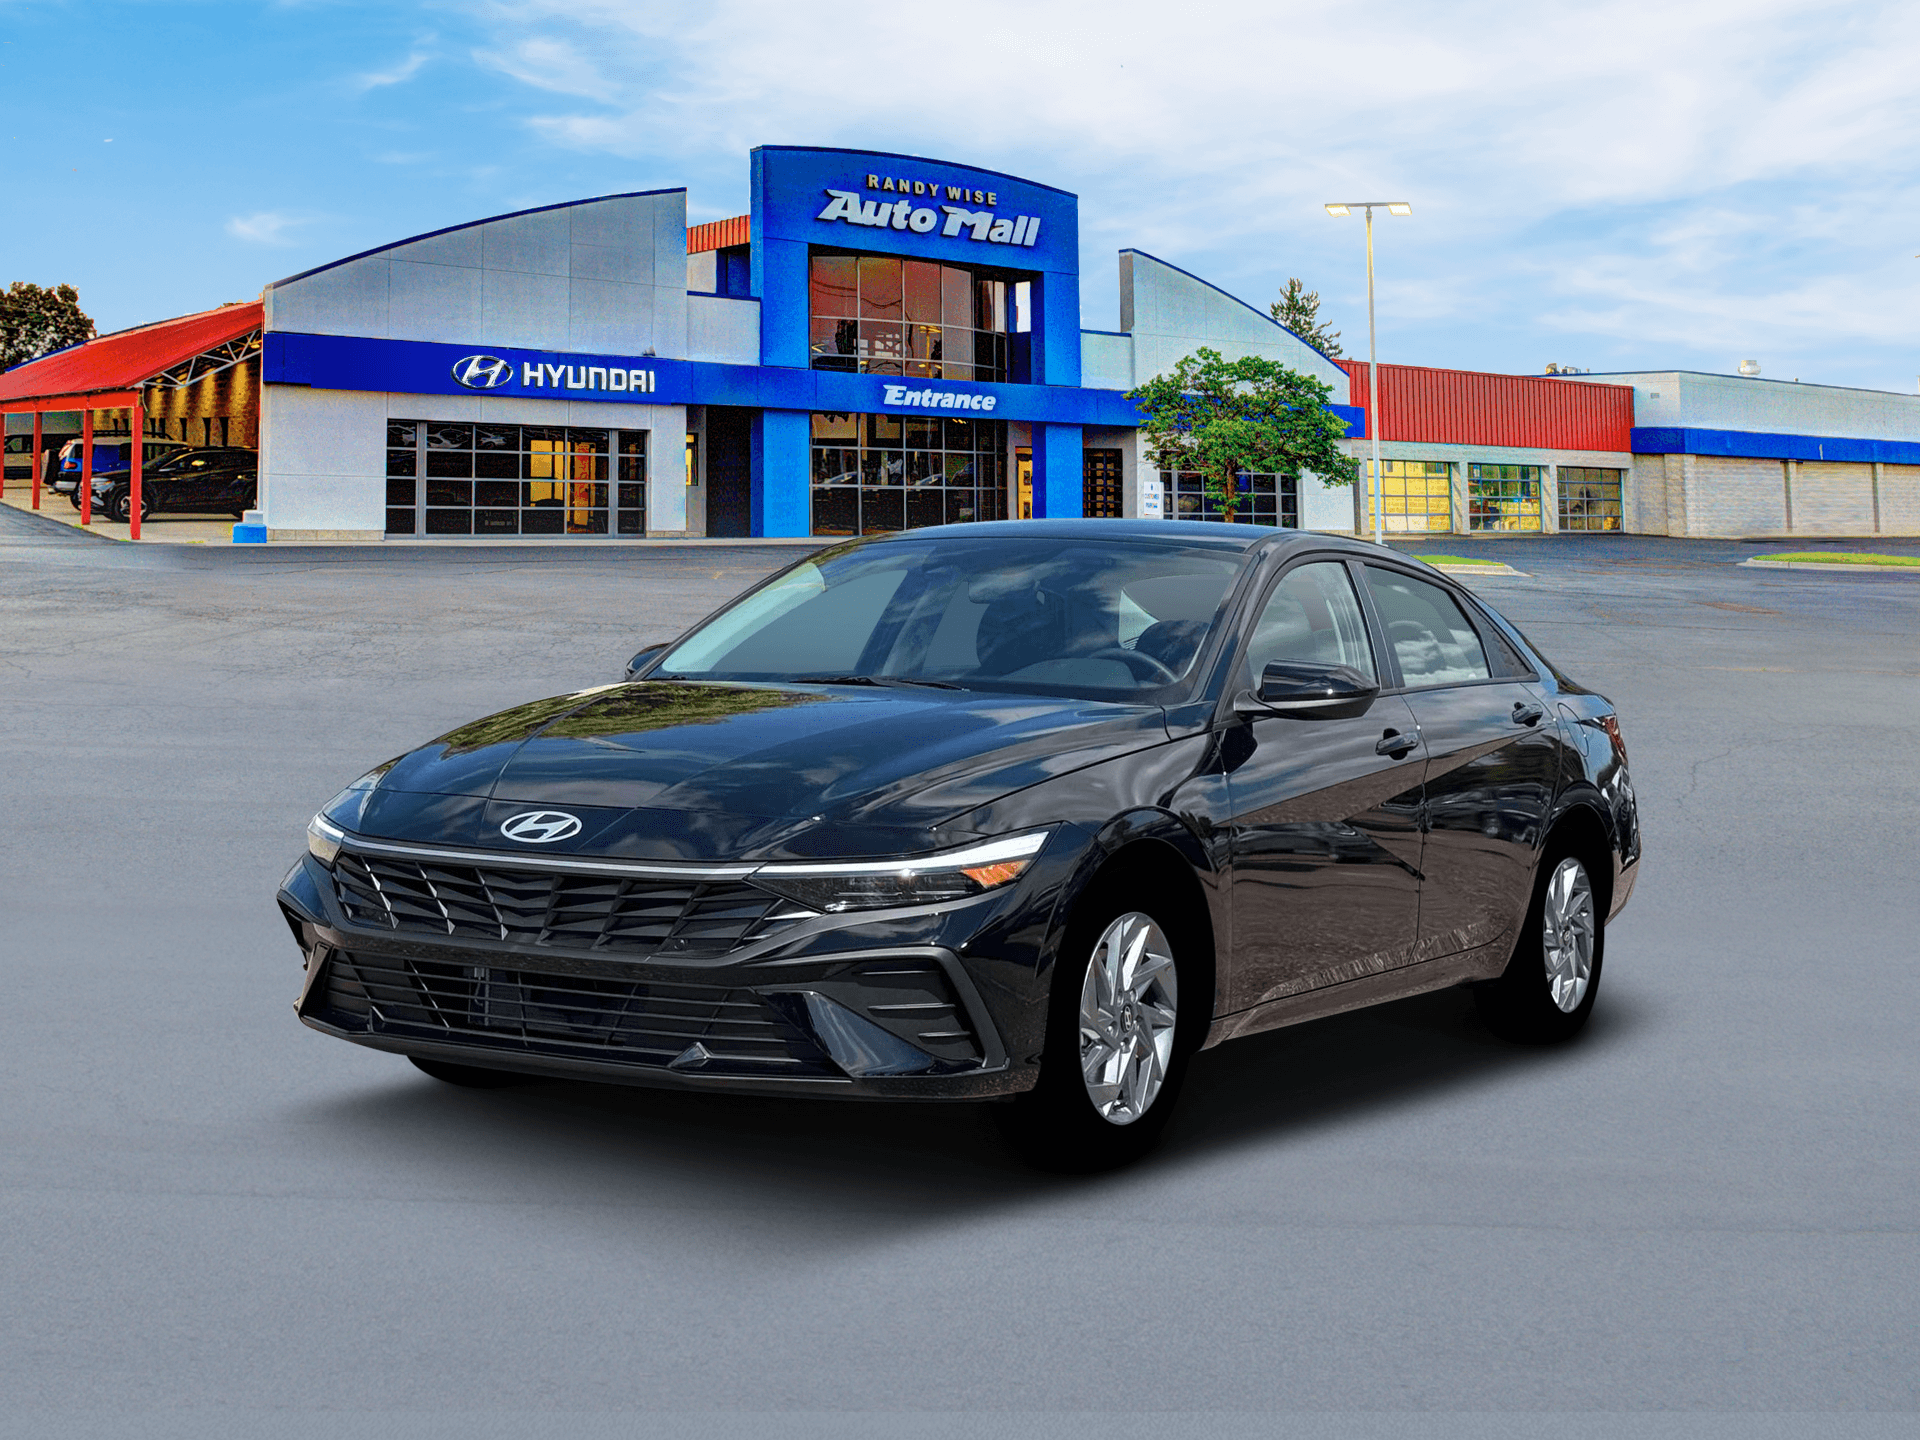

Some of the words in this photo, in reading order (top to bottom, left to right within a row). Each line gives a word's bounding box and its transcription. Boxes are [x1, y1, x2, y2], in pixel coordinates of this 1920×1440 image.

[866, 174, 939, 197] RANDY
[945, 186, 997, 206] WISE
[816, 188, 938, 233] Auto
[941, 205, 1041, 247] Mall
[522, 361, 655, 393] HYUNDAI
[883, 384, 997, 411] Entrance
